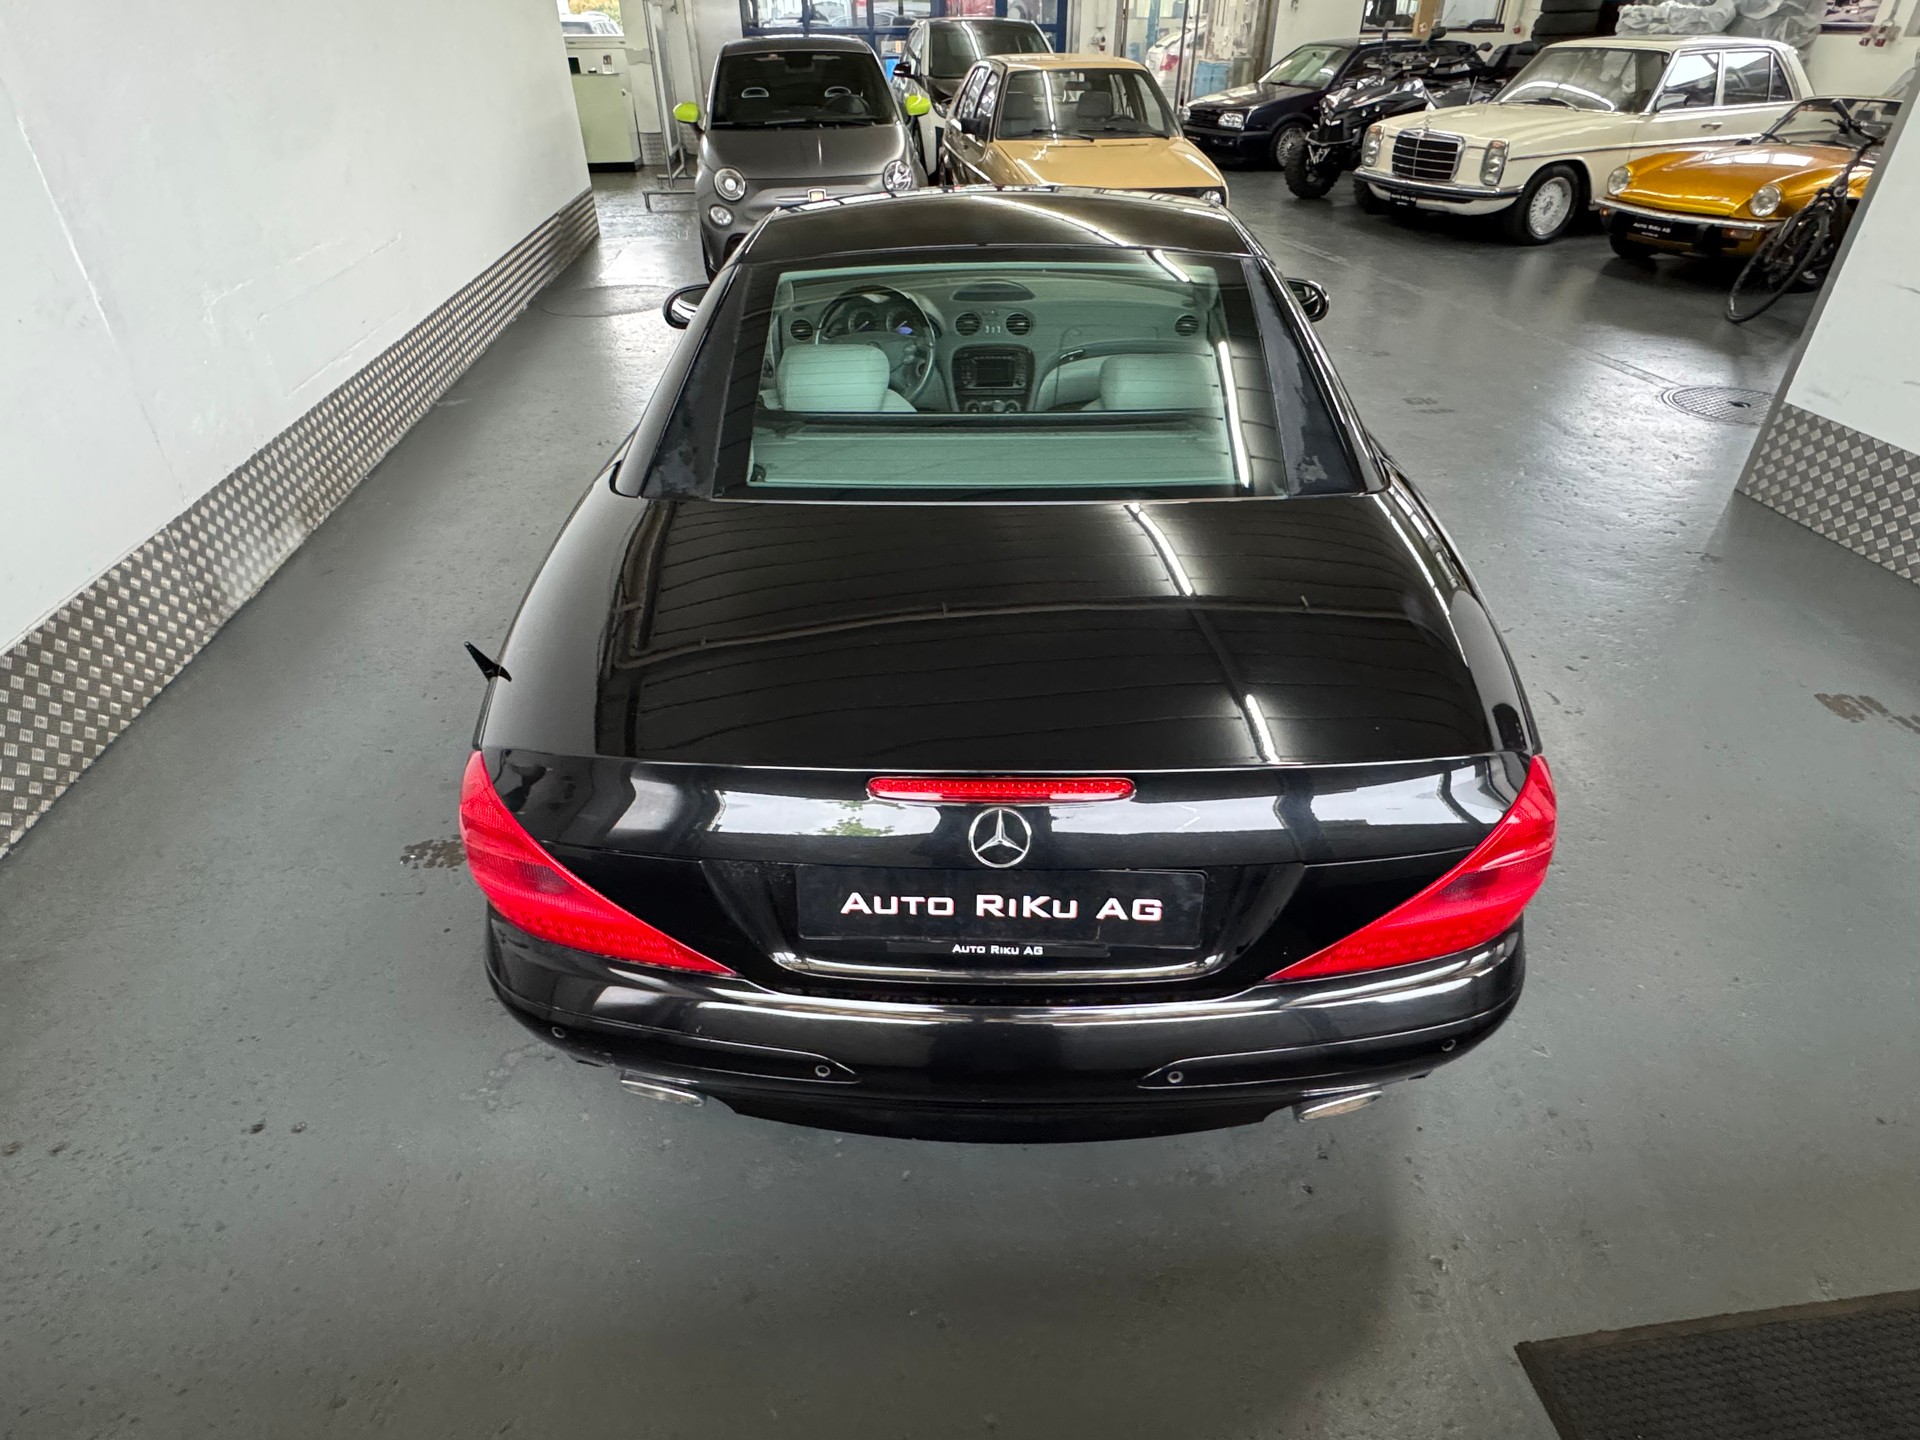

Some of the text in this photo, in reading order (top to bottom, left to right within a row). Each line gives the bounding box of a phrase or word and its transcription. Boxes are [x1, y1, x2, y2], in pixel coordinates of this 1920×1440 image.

[840, 891, 955, 916] AUTO
[1095, 897, 1164, 922] AG
[952, 943, 986, 954] AUTO
[1023, 945, 1044, 956] AG
